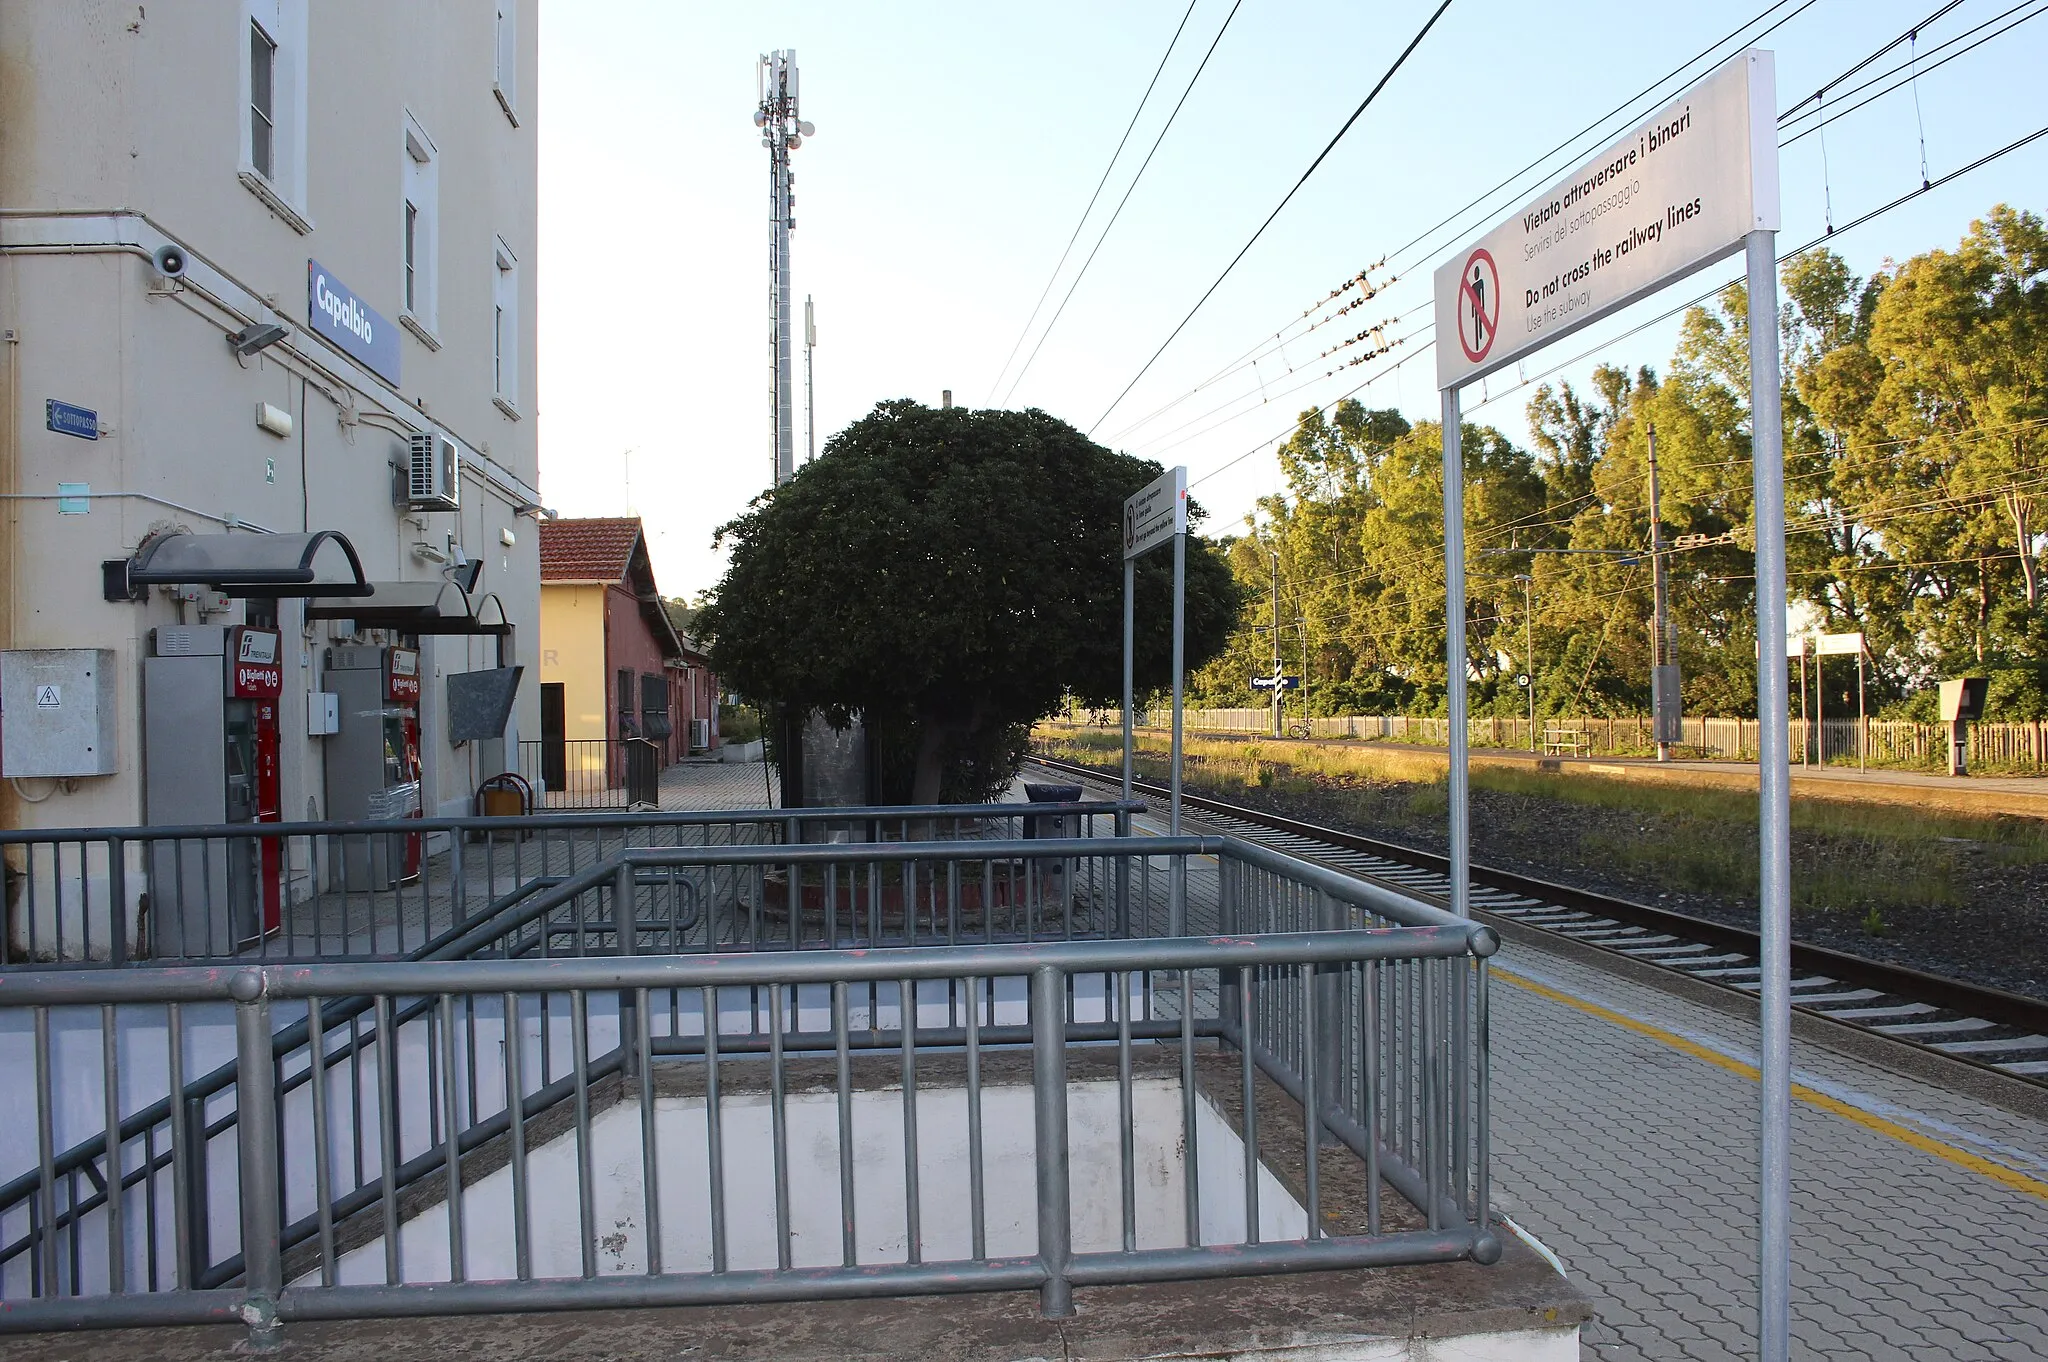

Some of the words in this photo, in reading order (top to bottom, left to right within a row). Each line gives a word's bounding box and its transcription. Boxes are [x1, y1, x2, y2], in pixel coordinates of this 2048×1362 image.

[1523, 200, 1561, 234] Vietato
[1563, 148, 1637, 209] attraversare
[1640, 137, 1645, 158] i
[1648, 105, 1691, 153] binari
[1524, 235, 1552, 262] Servirsi
[1554, 218, 1568, 243] del
[1569, 178, 1640, 234] sottopassaggio
[1525, 288, 1540, 309] Do
[1542, 275, 1560, 300] not
[1562, 260, 1590, 288] cross
[1592, 248, 1612, 272] the
[1615, 217, 1664, 259] railway
[1666, 197, 1701, 230] lines
[316, 274, 373, 345] Capalbio
[1526, 314, 1542, 333] Use
[1543, 305, 1557, 323] the
[1558, 288, 1592, 317] subway
[63, 411, 96, 431] SOTTOPASSO
[247, 669, 265, 682] Biglietti
[251, 650, 272, 659] TRENITALIA
